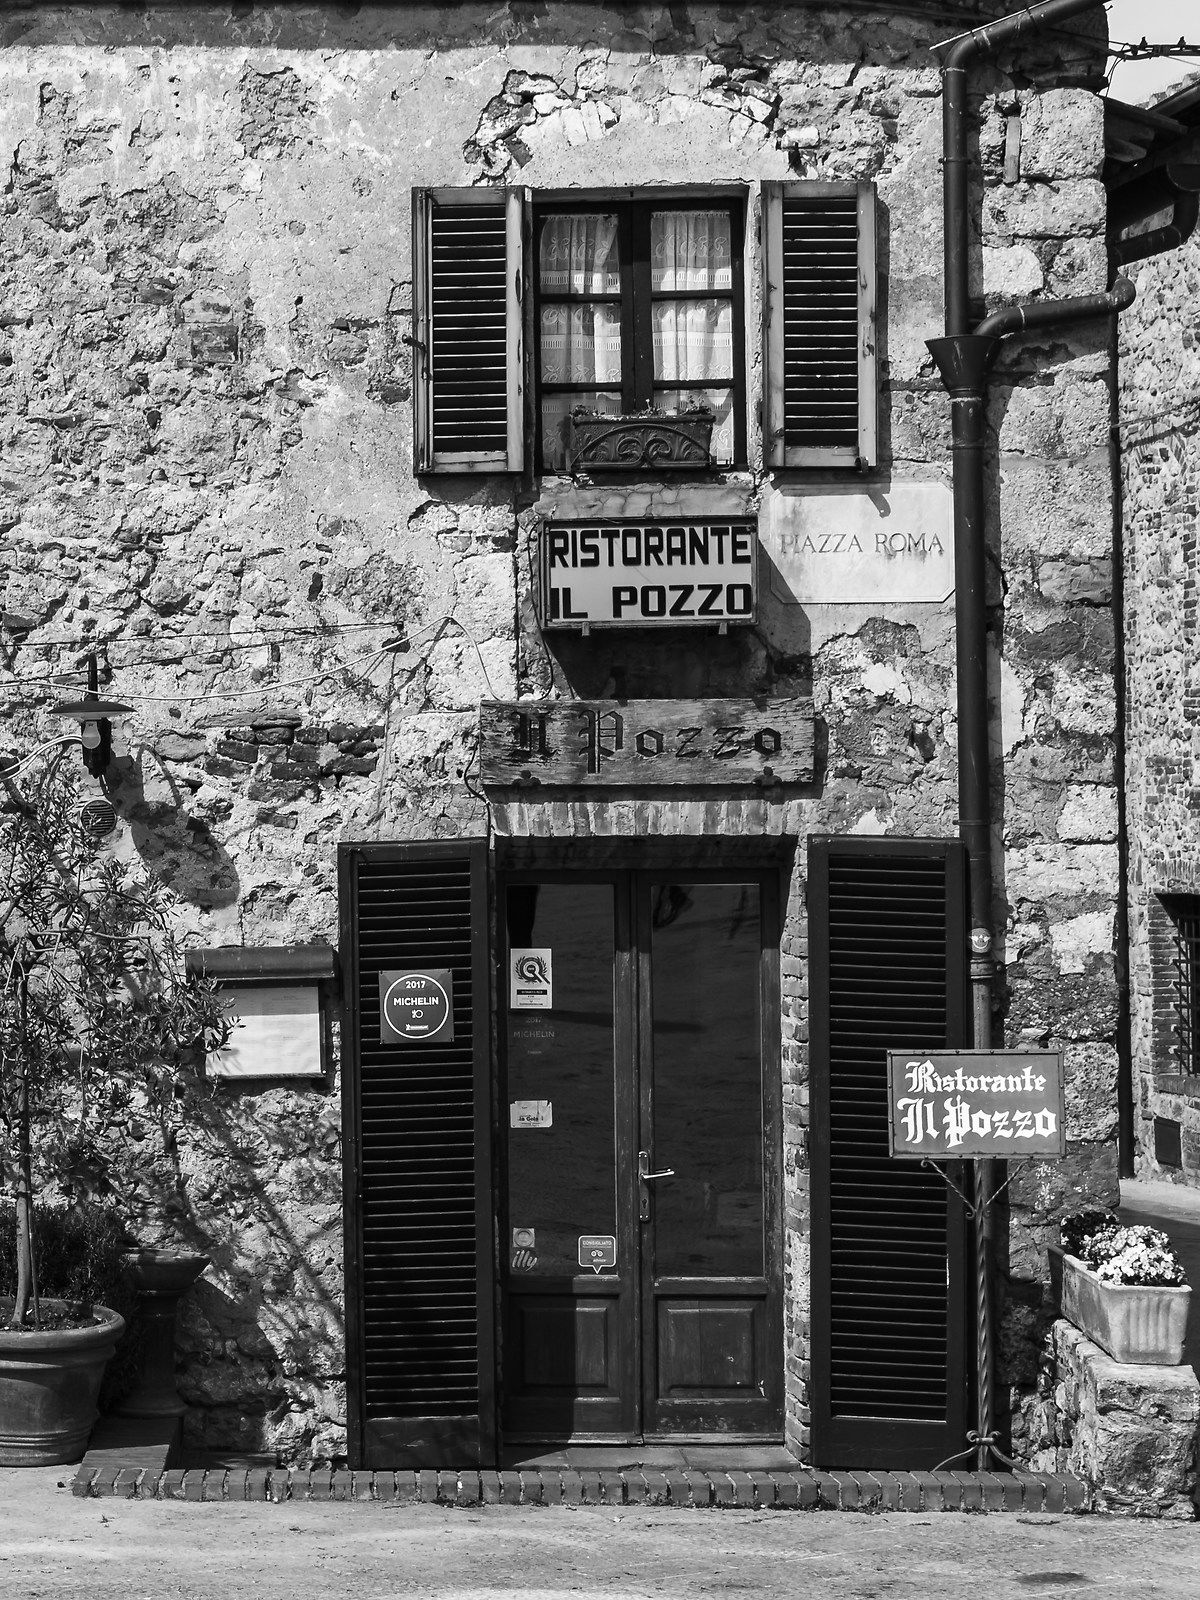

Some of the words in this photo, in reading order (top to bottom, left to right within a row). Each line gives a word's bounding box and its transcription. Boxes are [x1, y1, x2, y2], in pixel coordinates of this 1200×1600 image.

[550, 526, 751, 568] RISTORANTE
[781, 533, 863, 554] PIAZZA
[875, 533, 944, 556] ROMA
[550, 587, 588, 619] IL
[612, 584, 752, 619] POZZO
[578, 709, 783, 774] Pozzo
[405, 980, 426, 989] 2017
[393, 996, 439, 1006] MICHELIN
[513, 1030, 555, 1038] MICHELIN
[904, 1059, 1047, 1094] Ristorante
[896, 1097, 940, 1144] Il
[942, 1094, 1057, 1149] Pozzo
[512, 1250, 538, 1272] illy
